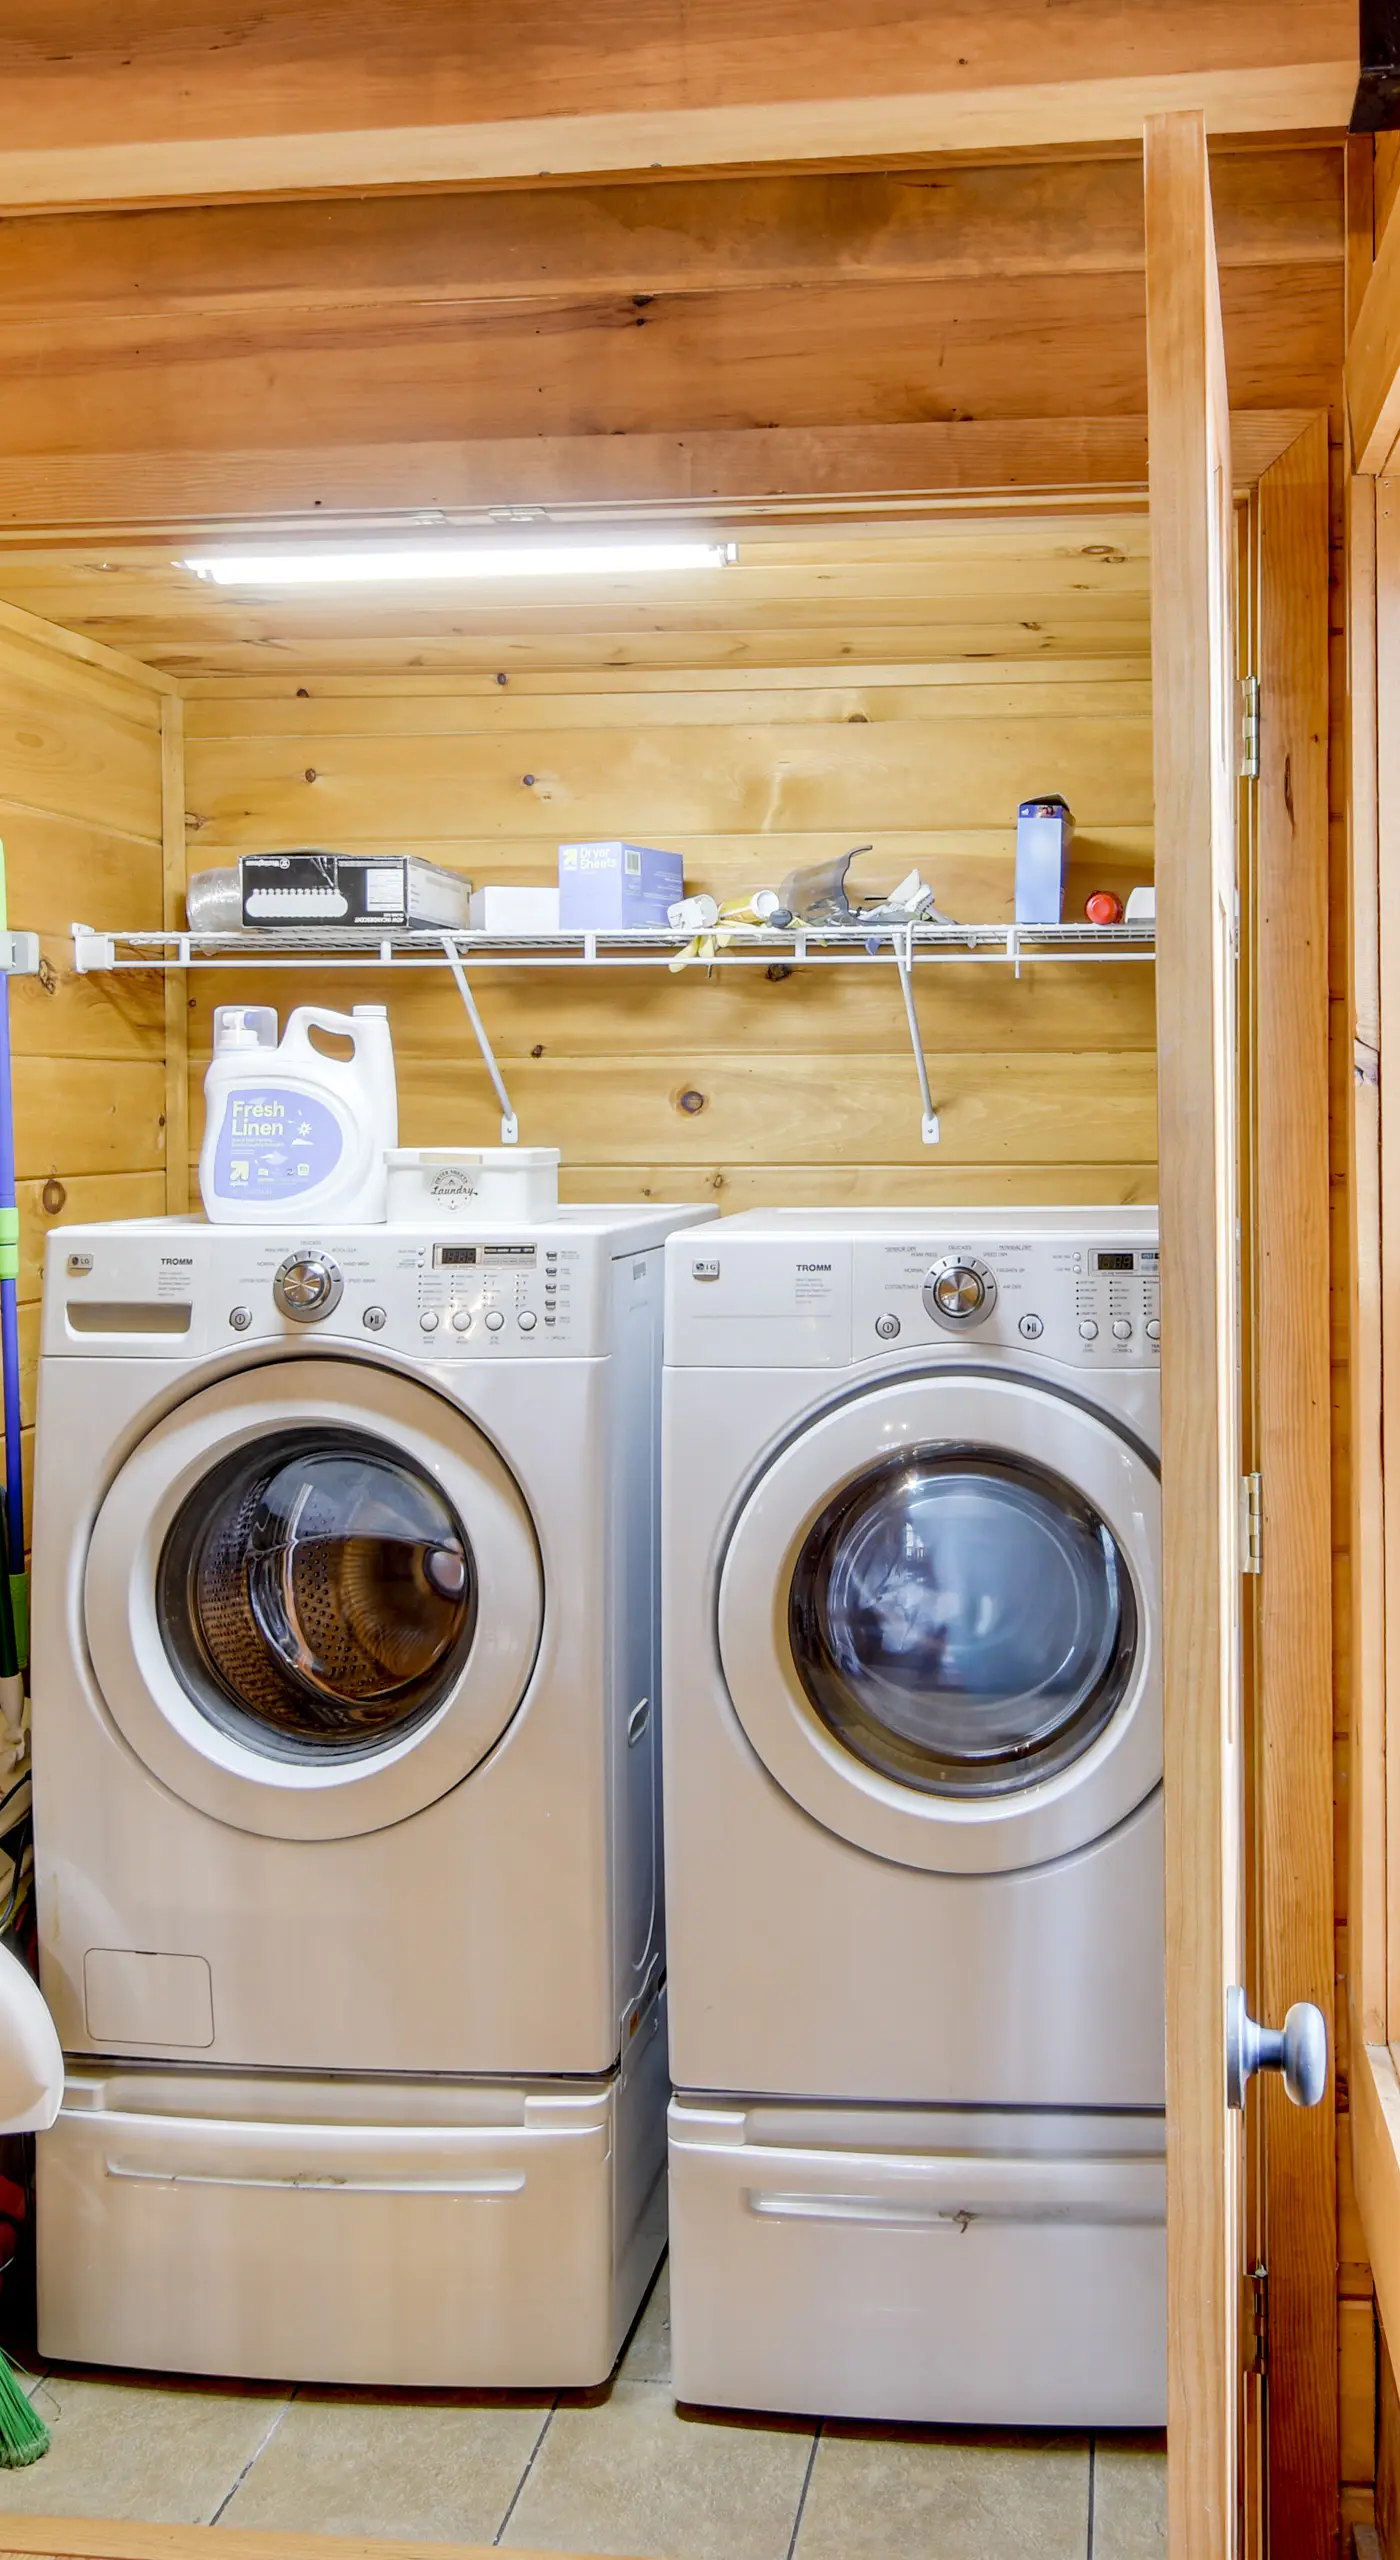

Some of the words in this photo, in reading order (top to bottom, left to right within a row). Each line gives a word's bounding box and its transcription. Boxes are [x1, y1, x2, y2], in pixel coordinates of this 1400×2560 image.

[580, 847, 610, 859] Dryer
[580, 858, 617, 870] Sheets
[232, 1100, 285, 1118] Fresh
[231, 1117, 284, 1136] Linen
[430, 1185, 475, 1197] Laundry
[161, 1258, 193, 1266] TROMM
[796, 1264, 832, 1272] TROMM
